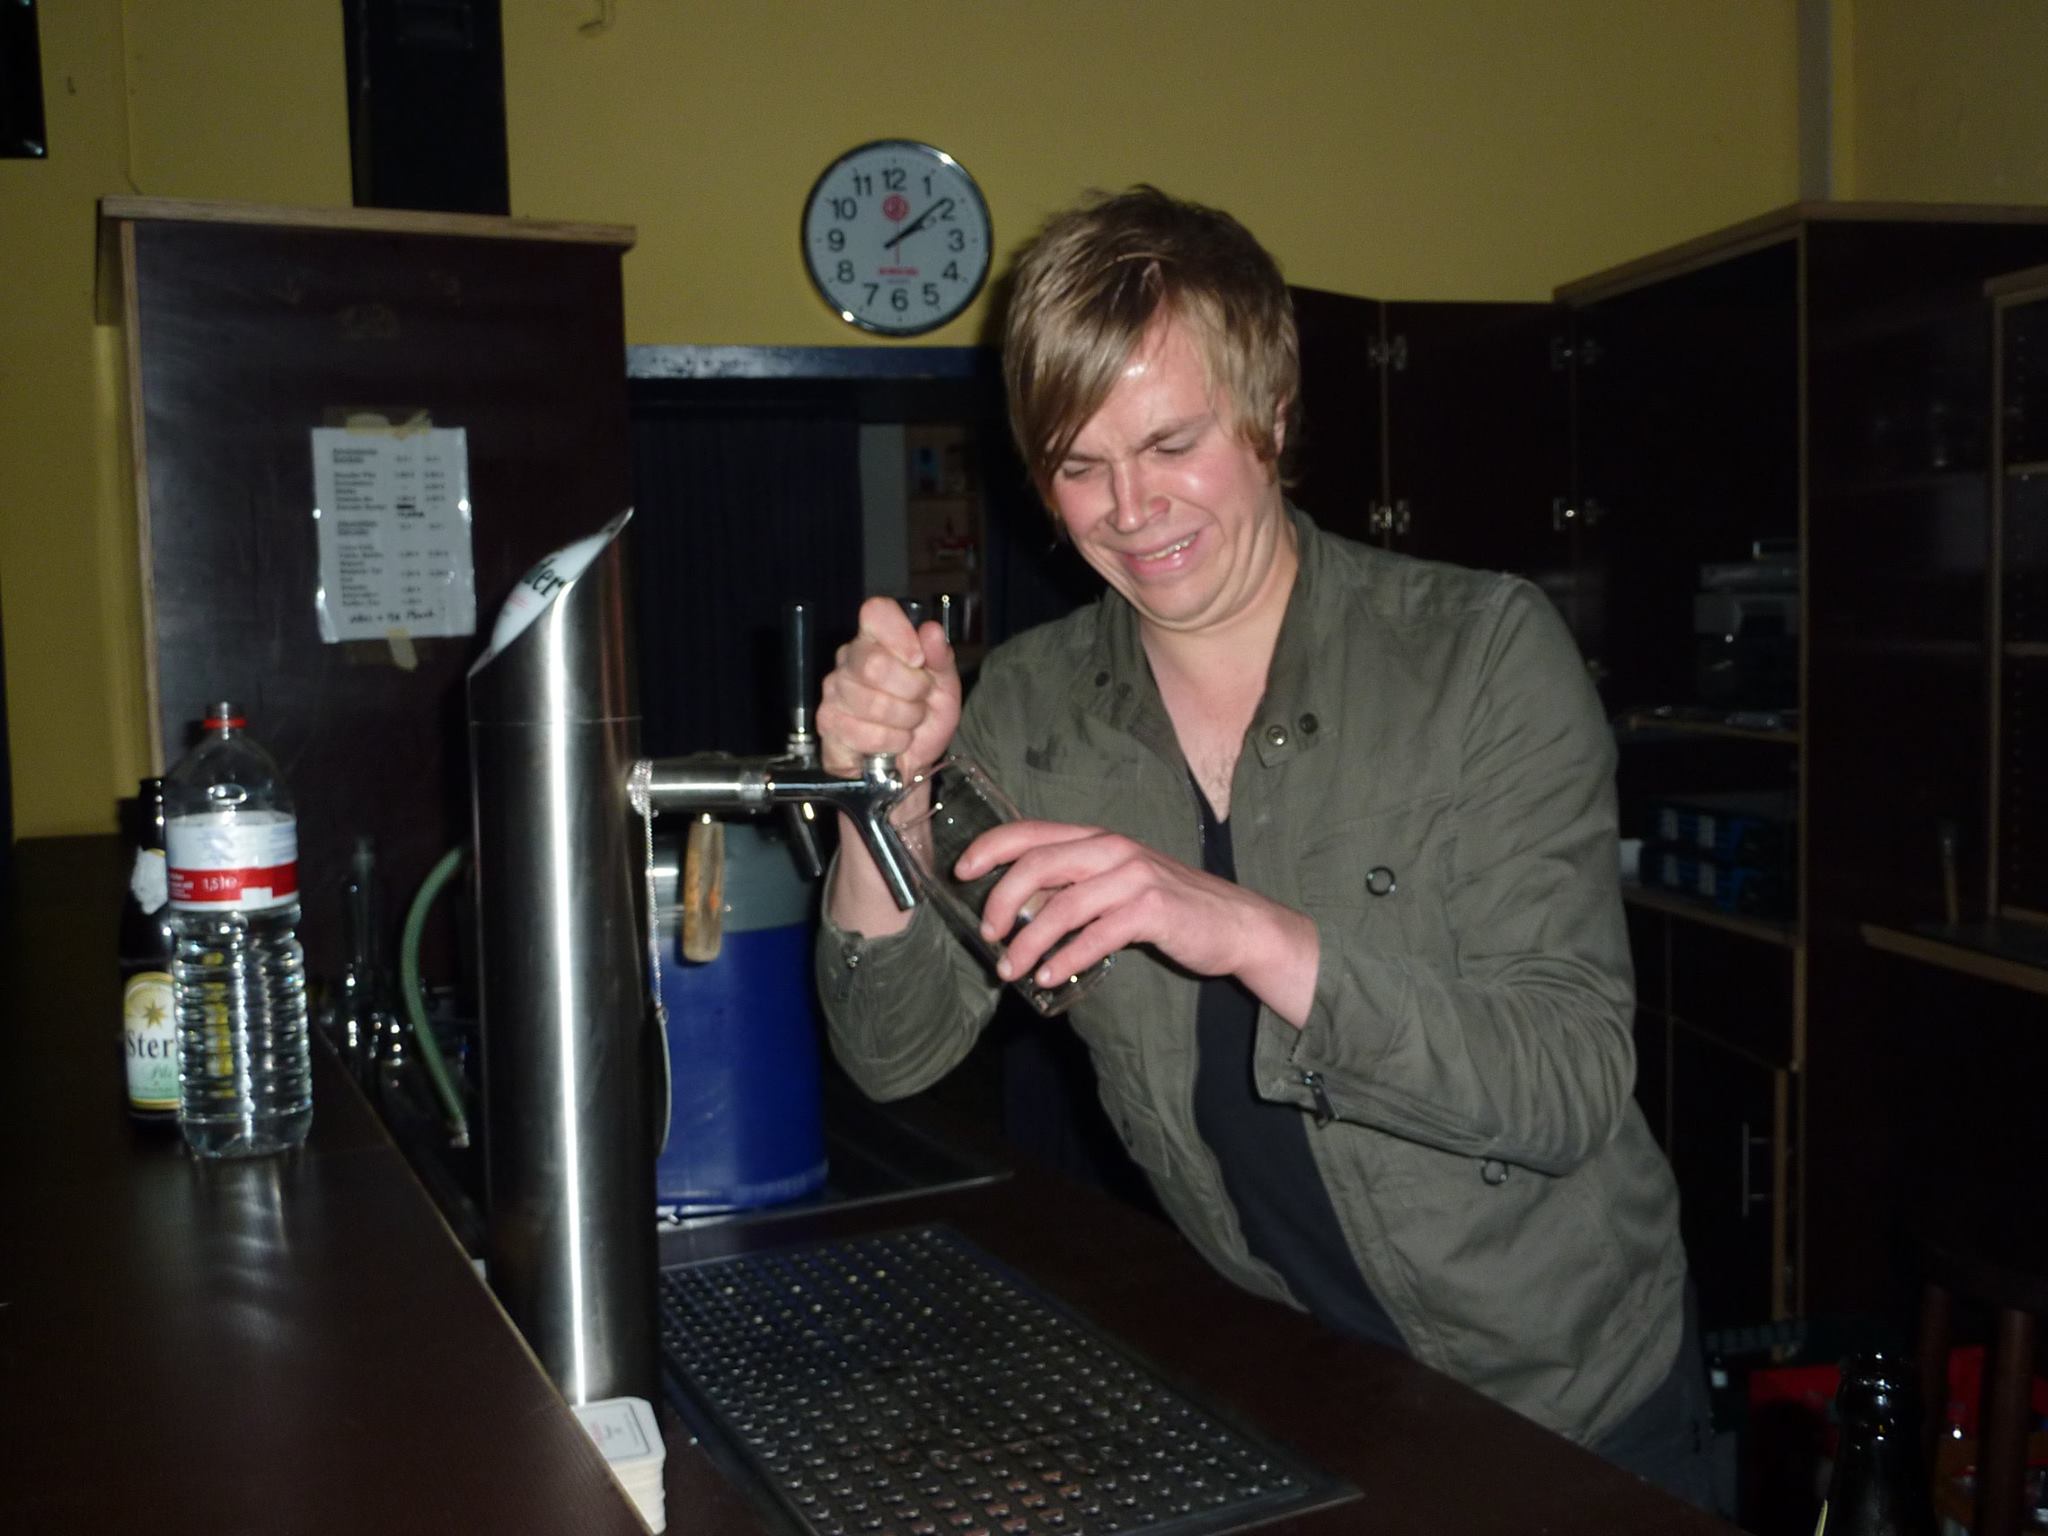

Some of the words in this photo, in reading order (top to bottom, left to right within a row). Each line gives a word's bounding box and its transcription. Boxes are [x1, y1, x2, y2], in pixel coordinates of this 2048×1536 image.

[853, 175, 873, 196] 11
[881, 168, 907, 191] 12
[921, 176, 932, 198] 1
[831, 197, 858, 221] 10
[940, 197, 955, 221] 2
[828, 229, 845, 252] 9
[948, 229, 965, 252] 3
[837, 260, 855, 284] 8
[943, 261, 959, 282] 4
[863, 283, 879, 306] 7
[891, 287, 909, 312] 6
[922, 283, 940, 306] 5
